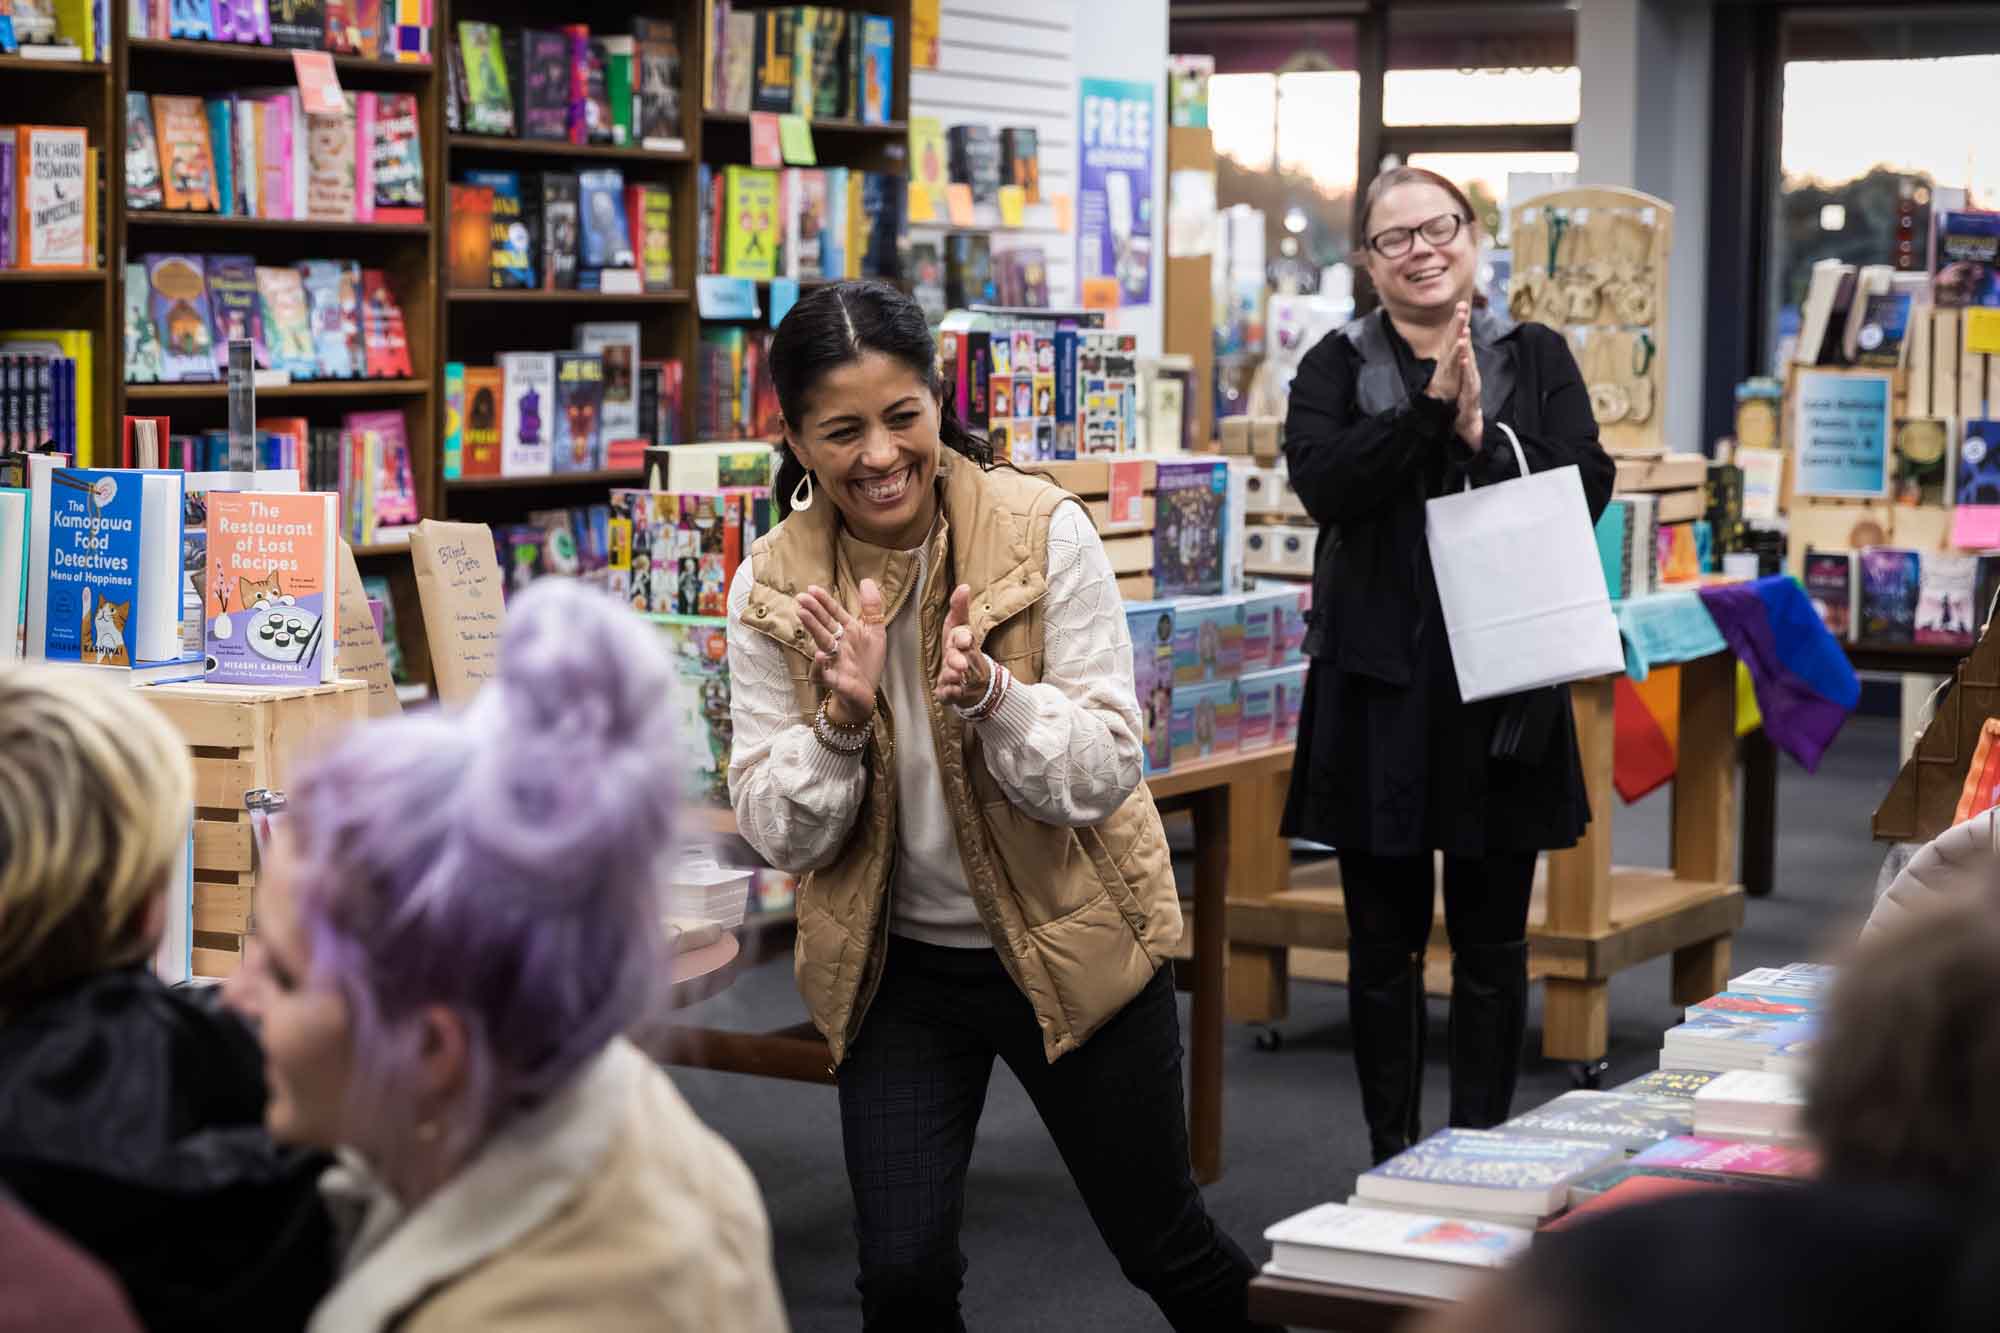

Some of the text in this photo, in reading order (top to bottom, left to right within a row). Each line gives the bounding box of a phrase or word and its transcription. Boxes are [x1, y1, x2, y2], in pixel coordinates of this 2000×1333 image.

[1084, 95, 1151, 148] FREE
[34, 141, 81, 158] RICHARD
[34, 160, 81, 178] OSMAN
[35, 200, 82, 228] IMPOSSIBLE
[68, 500, 85, 513] The
[249, 502, 280, 518] The
[53, 511, 132, 535] Kamogawa
[220, 517, 313, 536] Restaurant
[75, 531, 109, 550] Food
[236, 536, 294, 553] of Lost
[55, 548, 129, 571] Detectives
[231, 553, 299, 574] Recipes
[51, 570, 132, 587] Menu of Happiness
[83, 643, 123, 656] KASHIWAI
[260, 660, 303, 672] KASHIWAI
